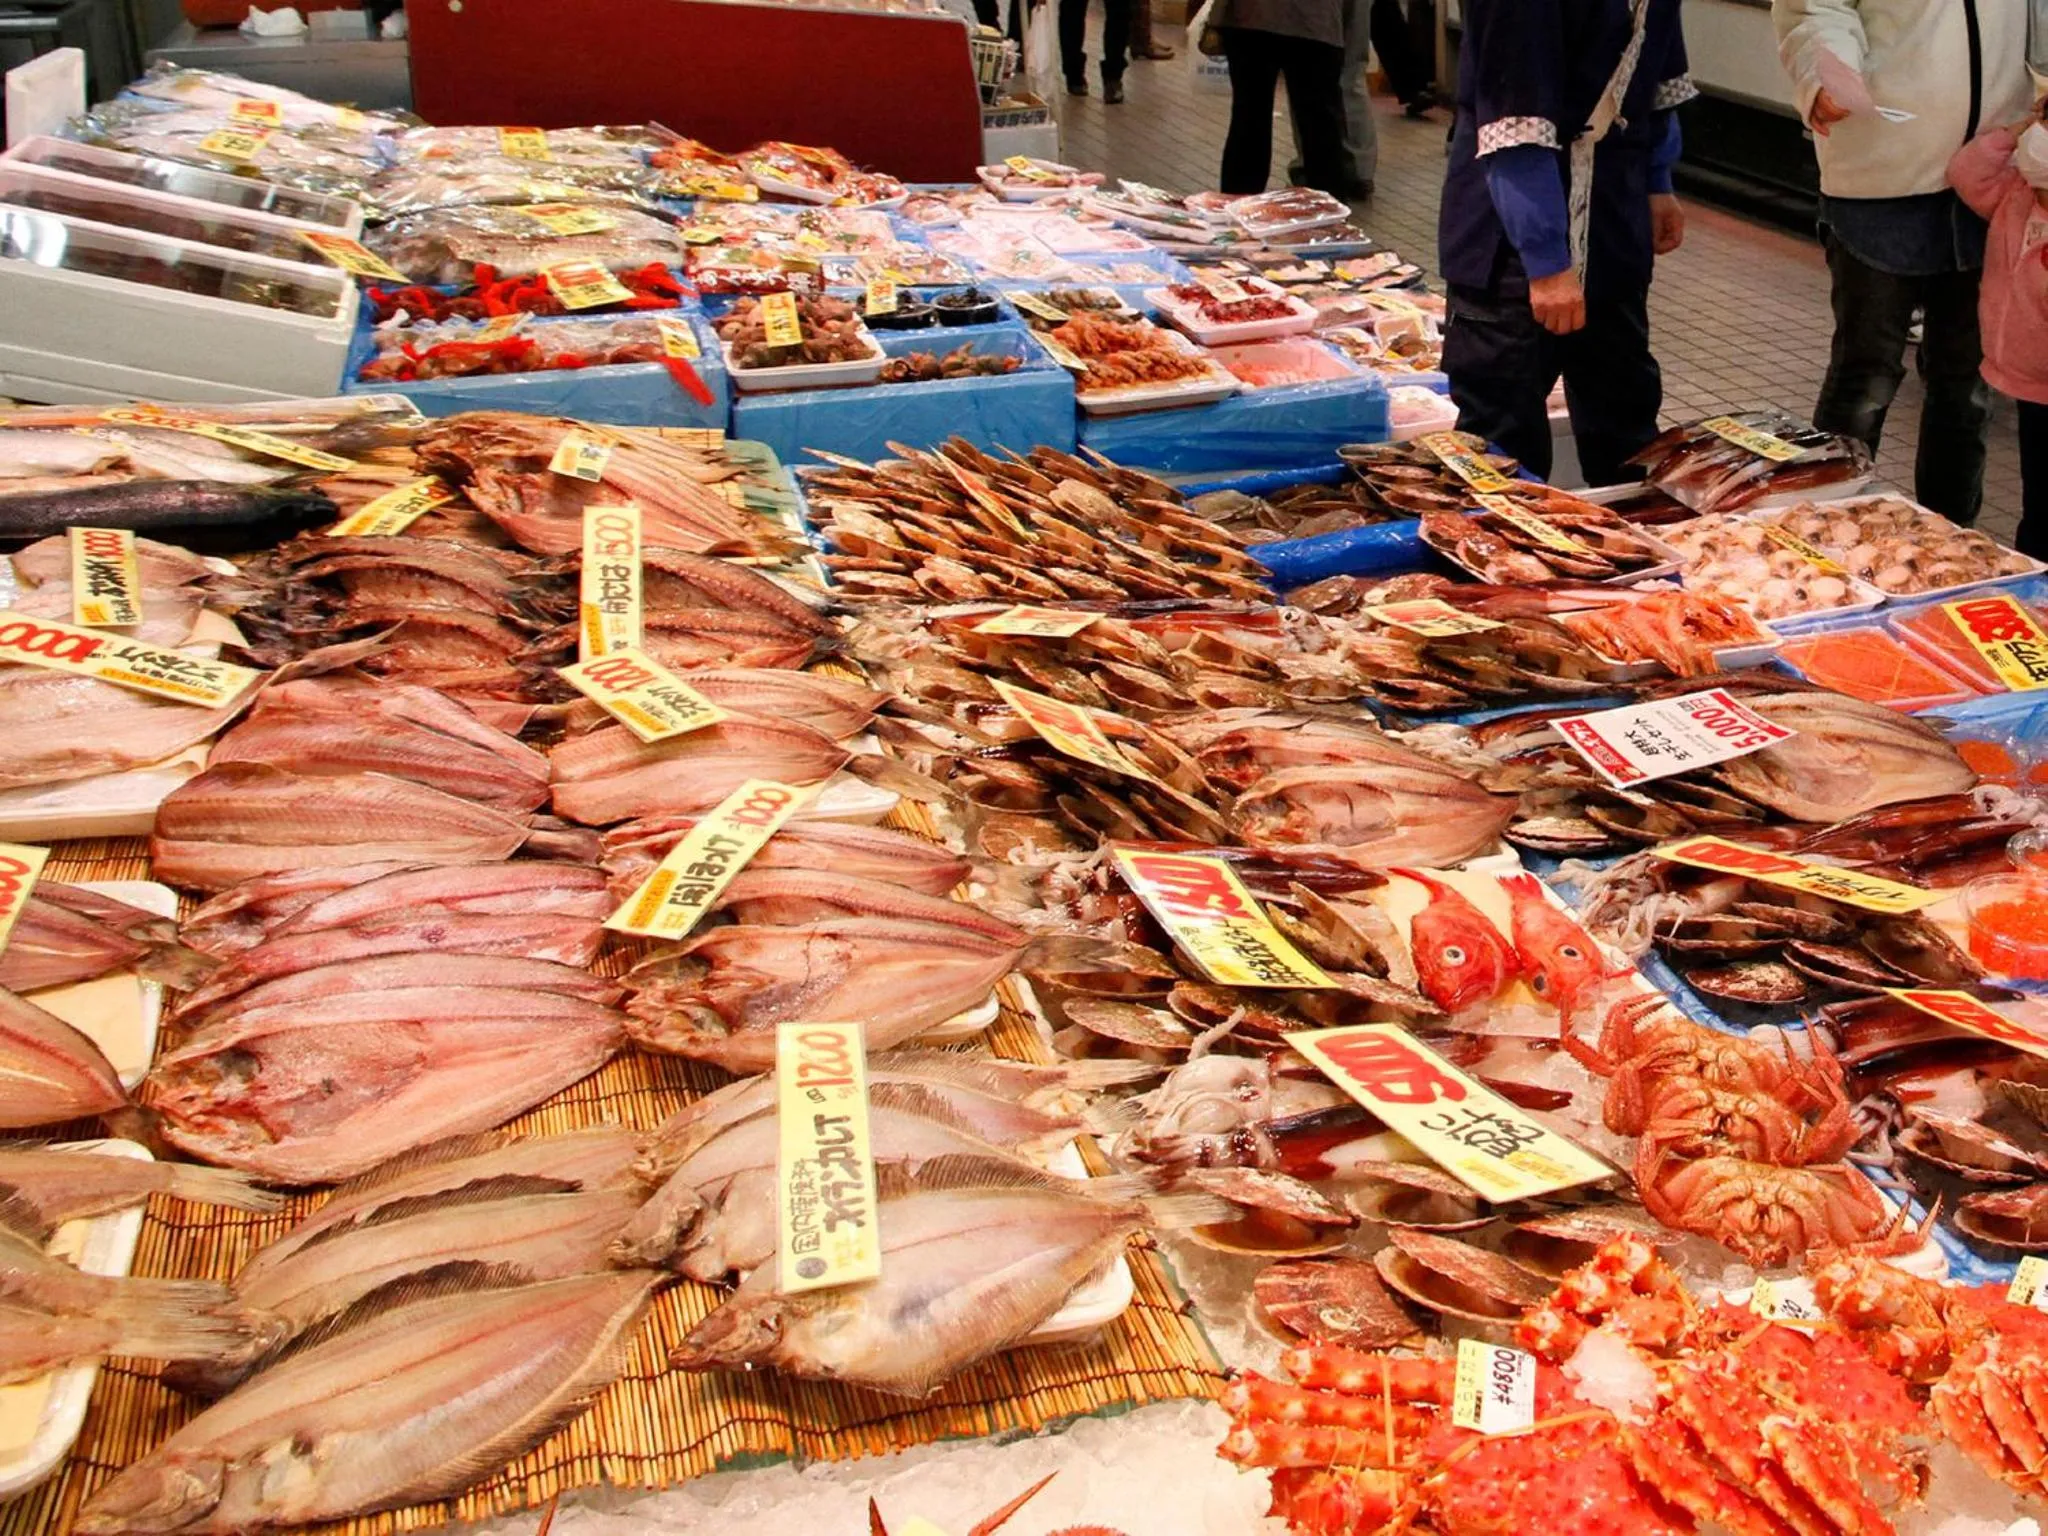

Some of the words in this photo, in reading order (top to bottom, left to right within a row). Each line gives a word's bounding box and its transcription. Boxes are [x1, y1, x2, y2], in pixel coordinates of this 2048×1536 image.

[582, 657, 659, 694] 1200
[722, 787, 793, 828] 1000
[795, 1030, 854, 1089] 1200
[1491, 1348, 1516, 1406] ¥4800
